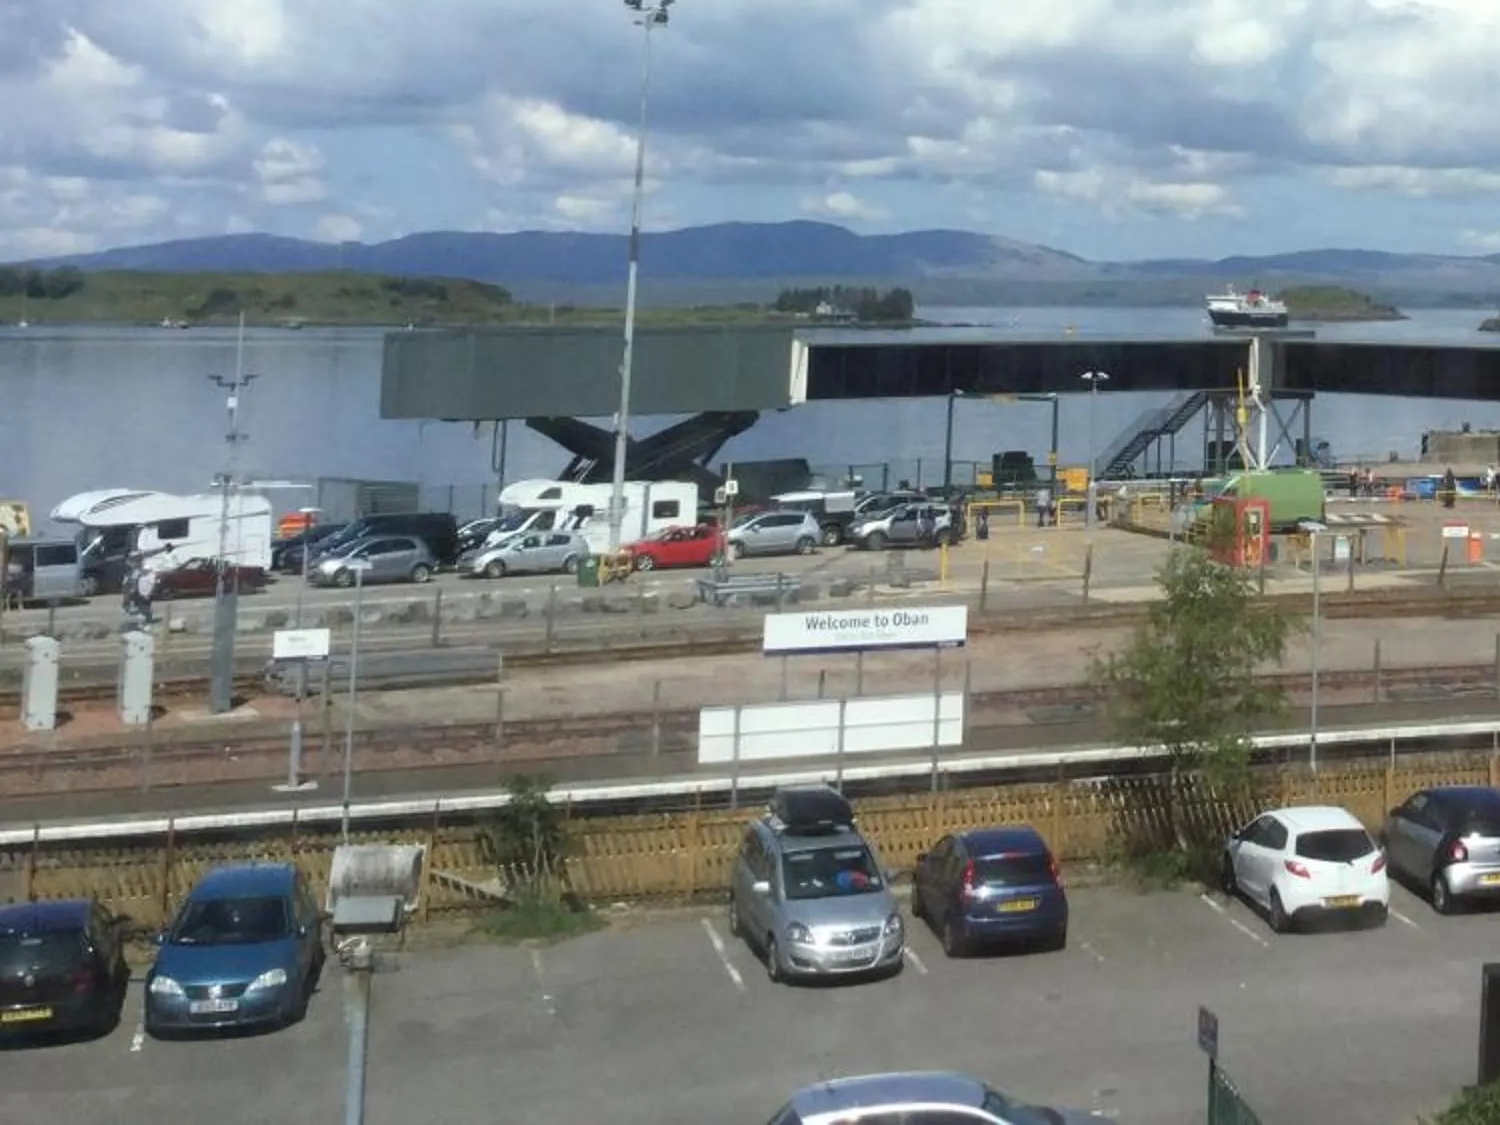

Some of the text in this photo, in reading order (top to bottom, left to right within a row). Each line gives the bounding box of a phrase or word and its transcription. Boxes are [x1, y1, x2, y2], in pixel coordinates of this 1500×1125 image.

[805, 612, 929, 630] Welcome to Oban
